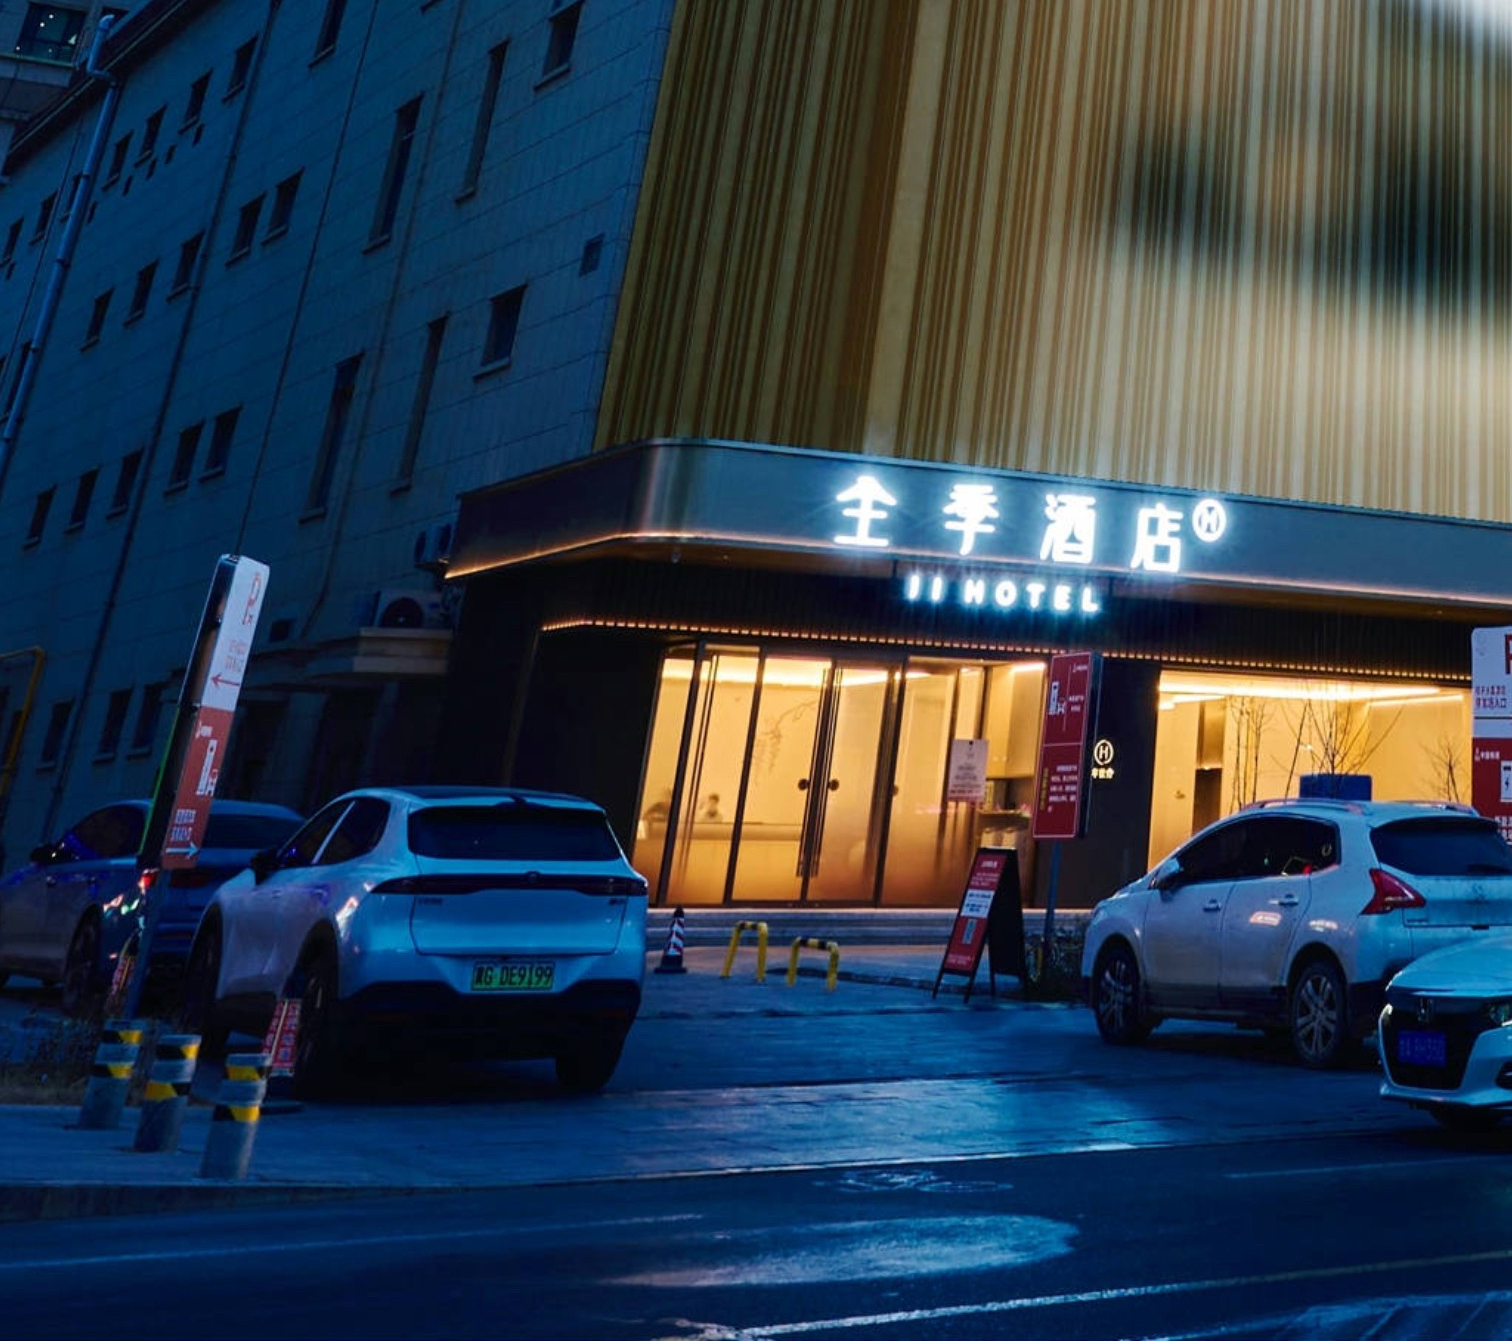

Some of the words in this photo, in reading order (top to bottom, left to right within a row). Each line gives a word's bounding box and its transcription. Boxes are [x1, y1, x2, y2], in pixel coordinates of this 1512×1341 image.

[835, 474, 1184, 575] 全季酒店
[964, 579, 1098, 612] HOTEL
